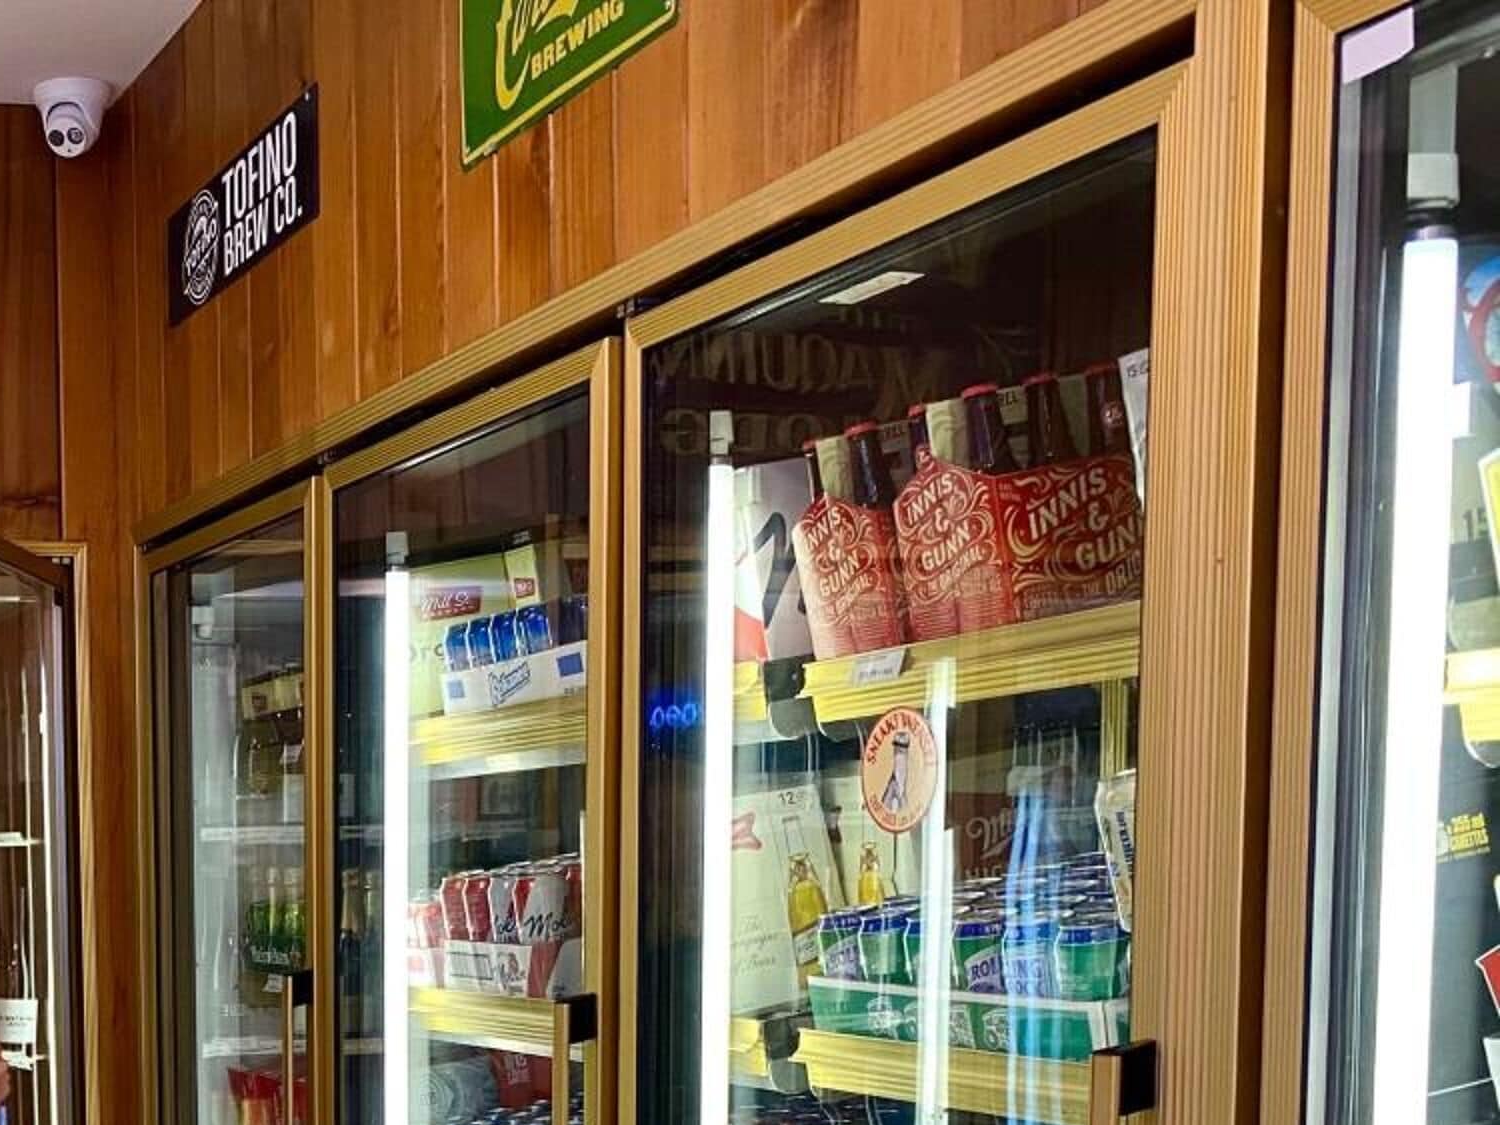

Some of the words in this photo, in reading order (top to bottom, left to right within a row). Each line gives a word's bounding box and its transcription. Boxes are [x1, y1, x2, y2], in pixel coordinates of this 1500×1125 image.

[531, 0, 624, 80] BREWING
[221, 111, 298, 228] TOFINO
[223, 198, 269, 277] BREW
[273, 175, 303, 234] CO.
[906, 473, 953, 525] INNIS
[935, 507, 950, 533] &
[1027, 467, 1107, 541] INNIS
[1088, 503, 1108, 531] &
[921, 521, 971, 571] GUNN
[819, 550, 860, 597] GUNN
